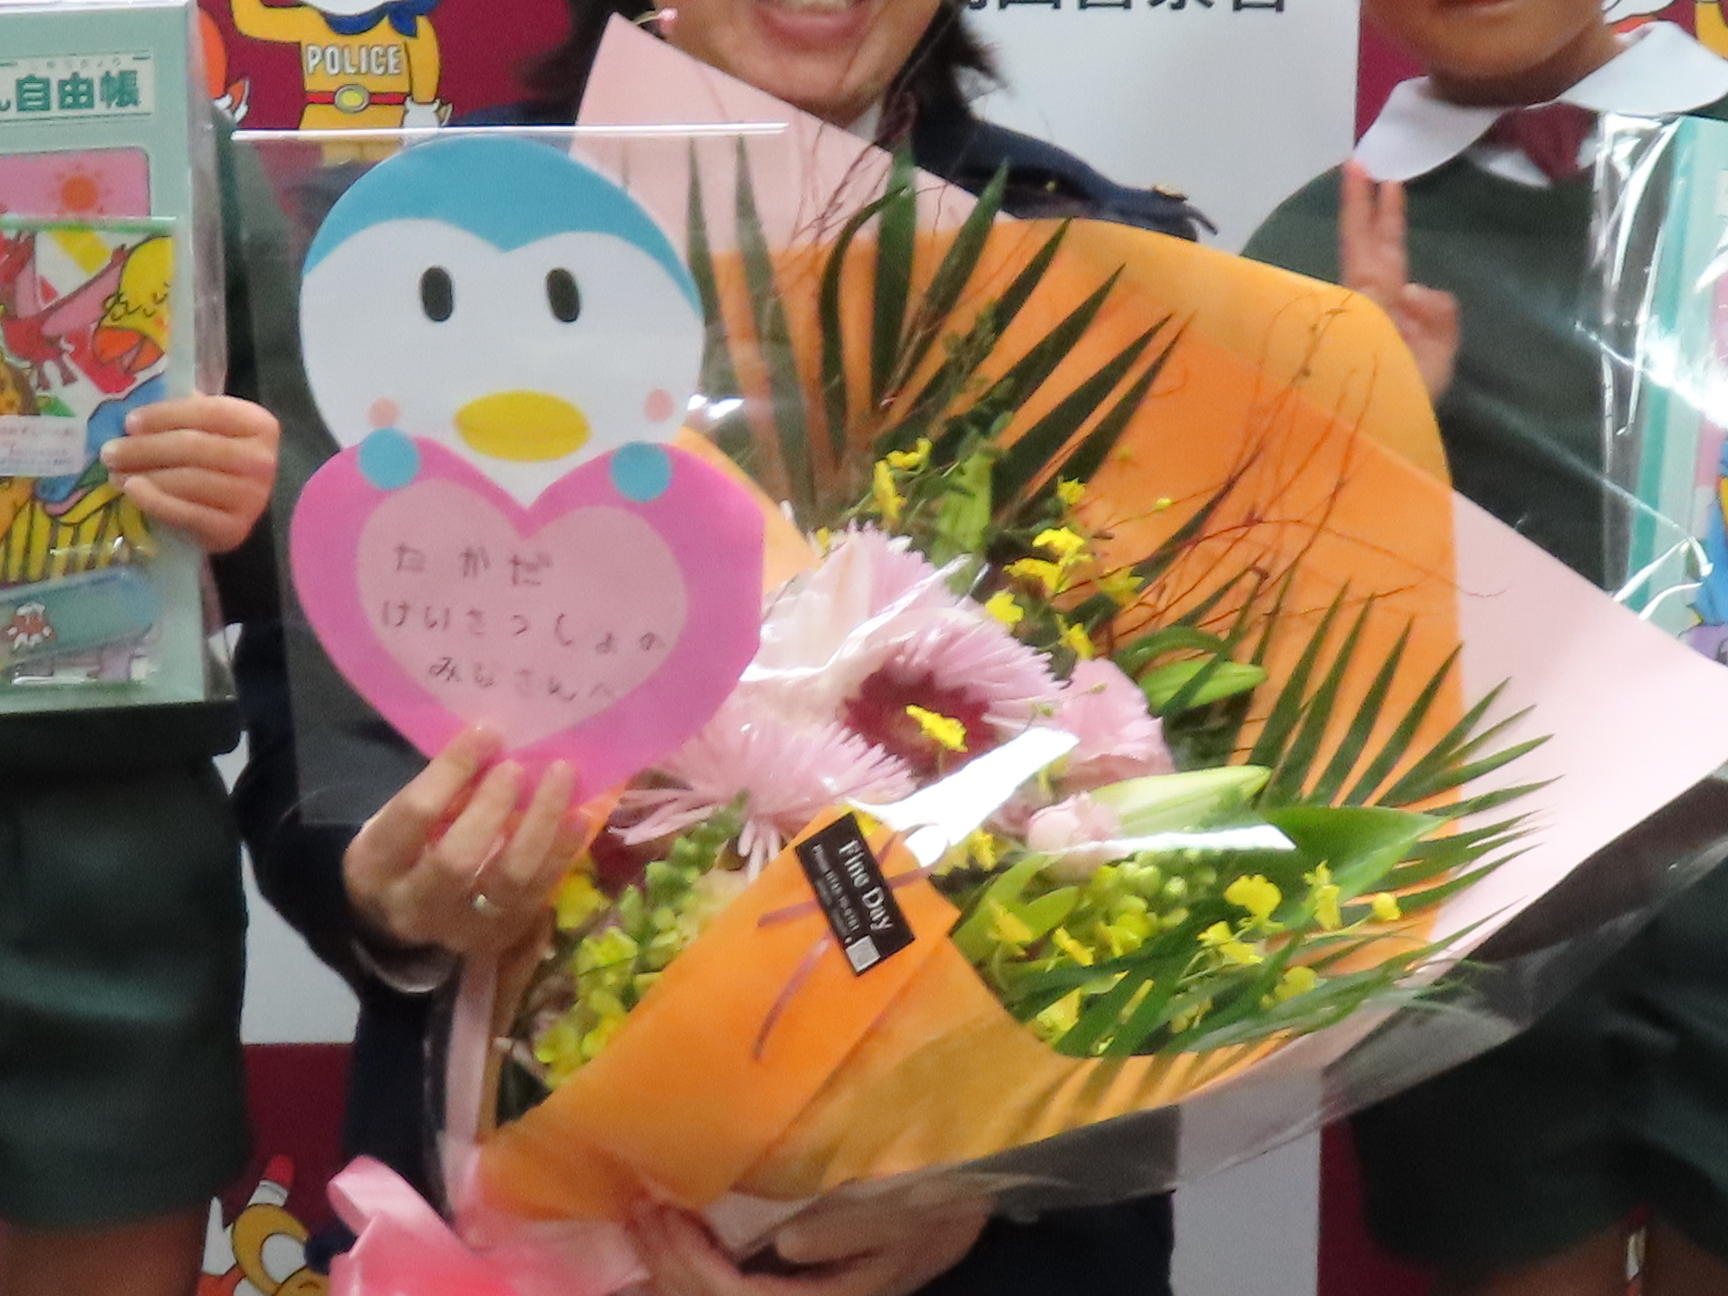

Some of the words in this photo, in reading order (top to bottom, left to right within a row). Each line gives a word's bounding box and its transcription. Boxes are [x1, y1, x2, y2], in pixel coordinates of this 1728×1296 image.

[305, 44, 404, 76] POLICE
[393, 541, 553, 588] たかだ
